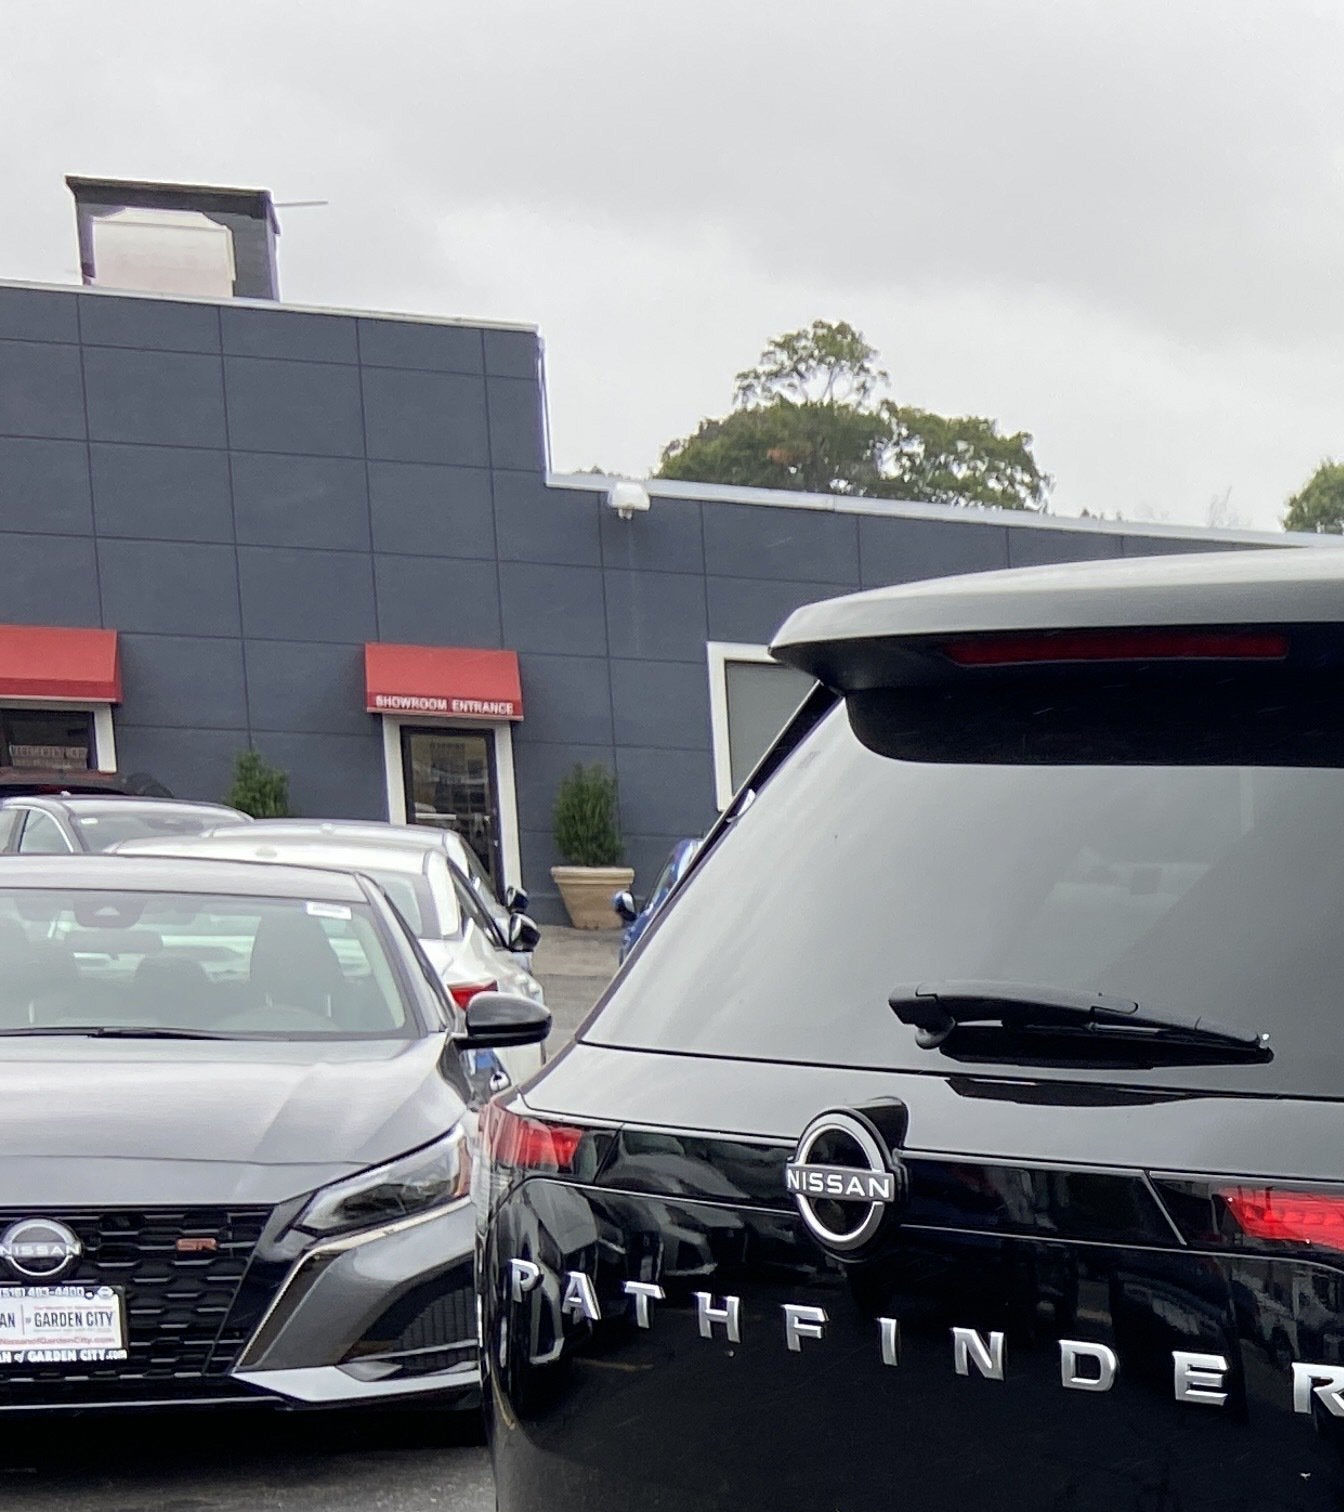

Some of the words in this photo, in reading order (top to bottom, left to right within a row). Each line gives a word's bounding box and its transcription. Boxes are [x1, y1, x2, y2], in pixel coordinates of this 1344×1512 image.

[376, 695, 448, 711] SHOWROOM
[452, 699, 514, 715] ENTRANCE
[786, 1169, 890, 1199] NISSAN
[34, 1312, 83, 1328] GARDEN
[86, 1311, 114, 1328] CITY
